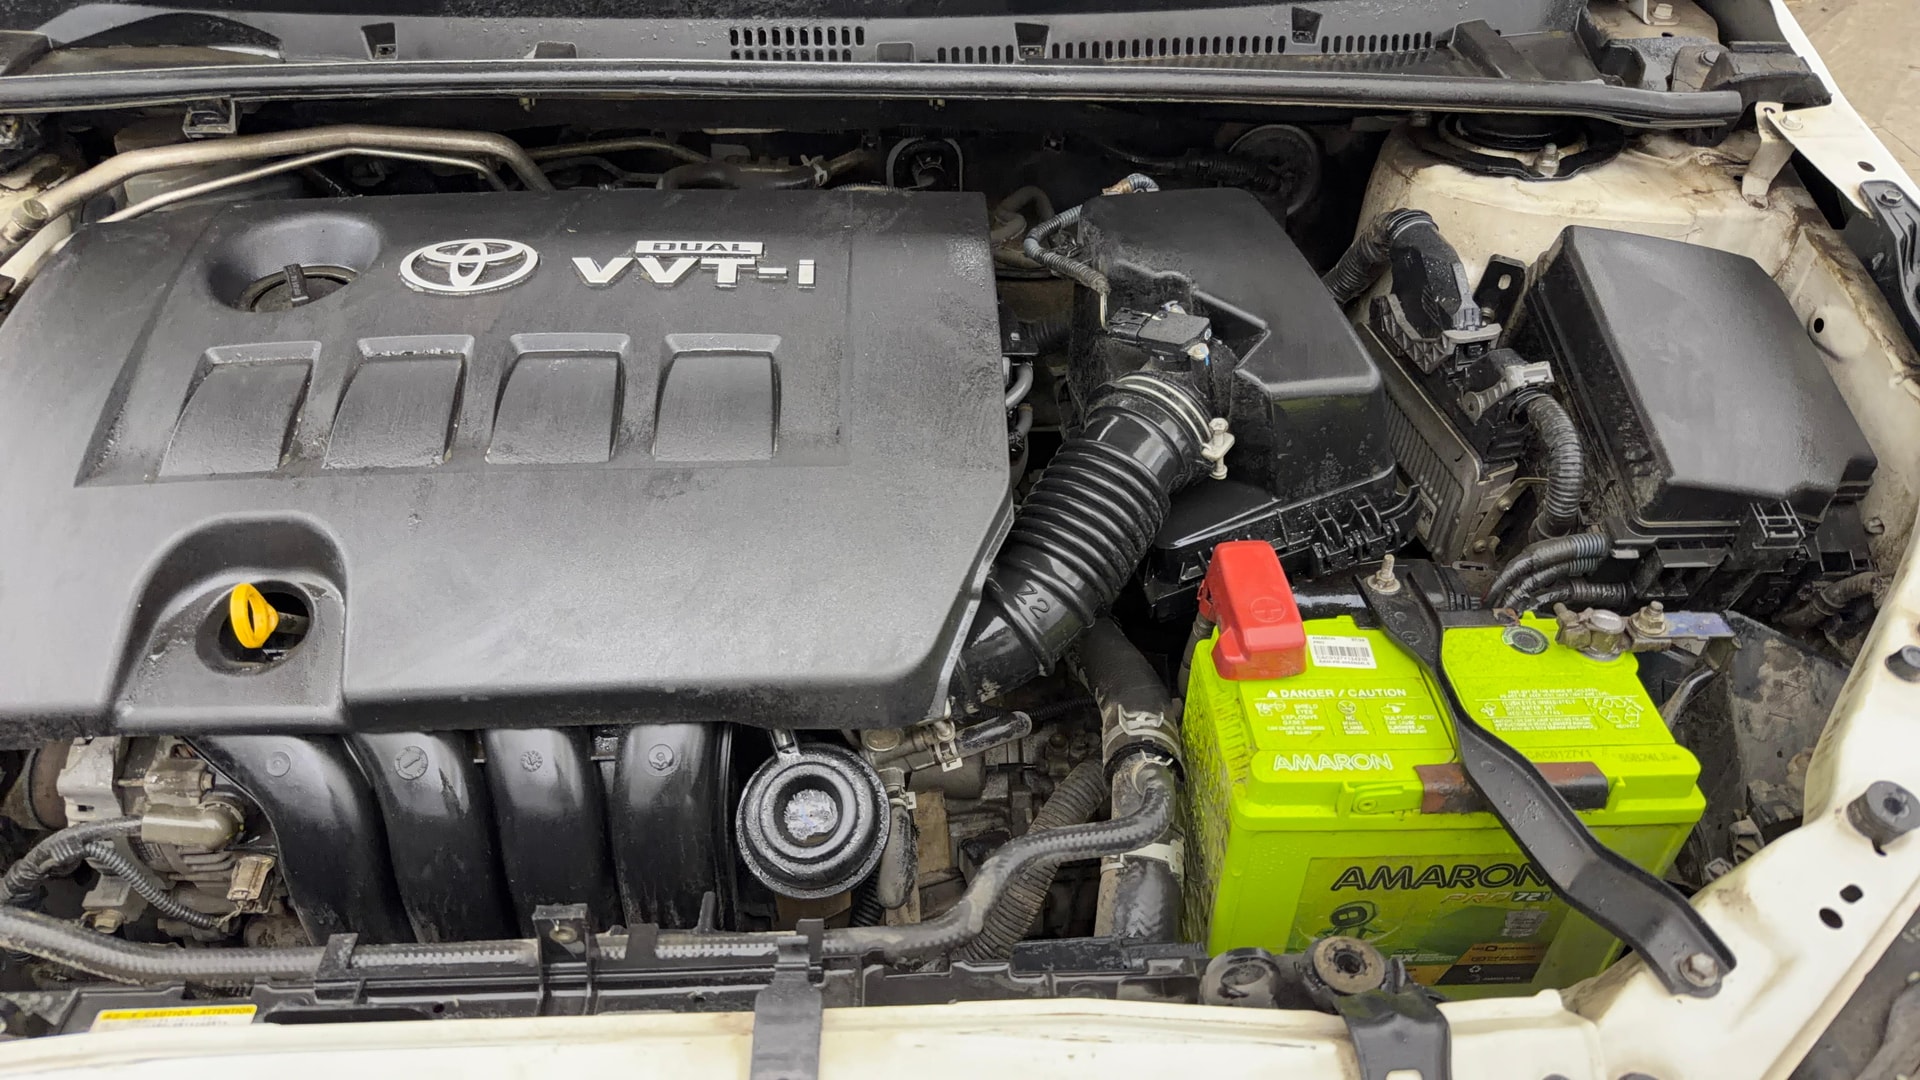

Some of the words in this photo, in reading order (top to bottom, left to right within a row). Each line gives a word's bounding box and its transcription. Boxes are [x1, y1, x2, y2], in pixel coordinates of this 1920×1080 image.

[650, 242, 754, 253] DUAL
[1279, 689, 1335, 698] DANGER
[1338, 689, 1345, 698] /
[1347, 688, 1407, 698] CAUTION
[1273, 753, 1393, 771] AMARON
[144, 1010, 192, 1018] CAUTION
[200, 1007, 253, 1015] ATTENTION
